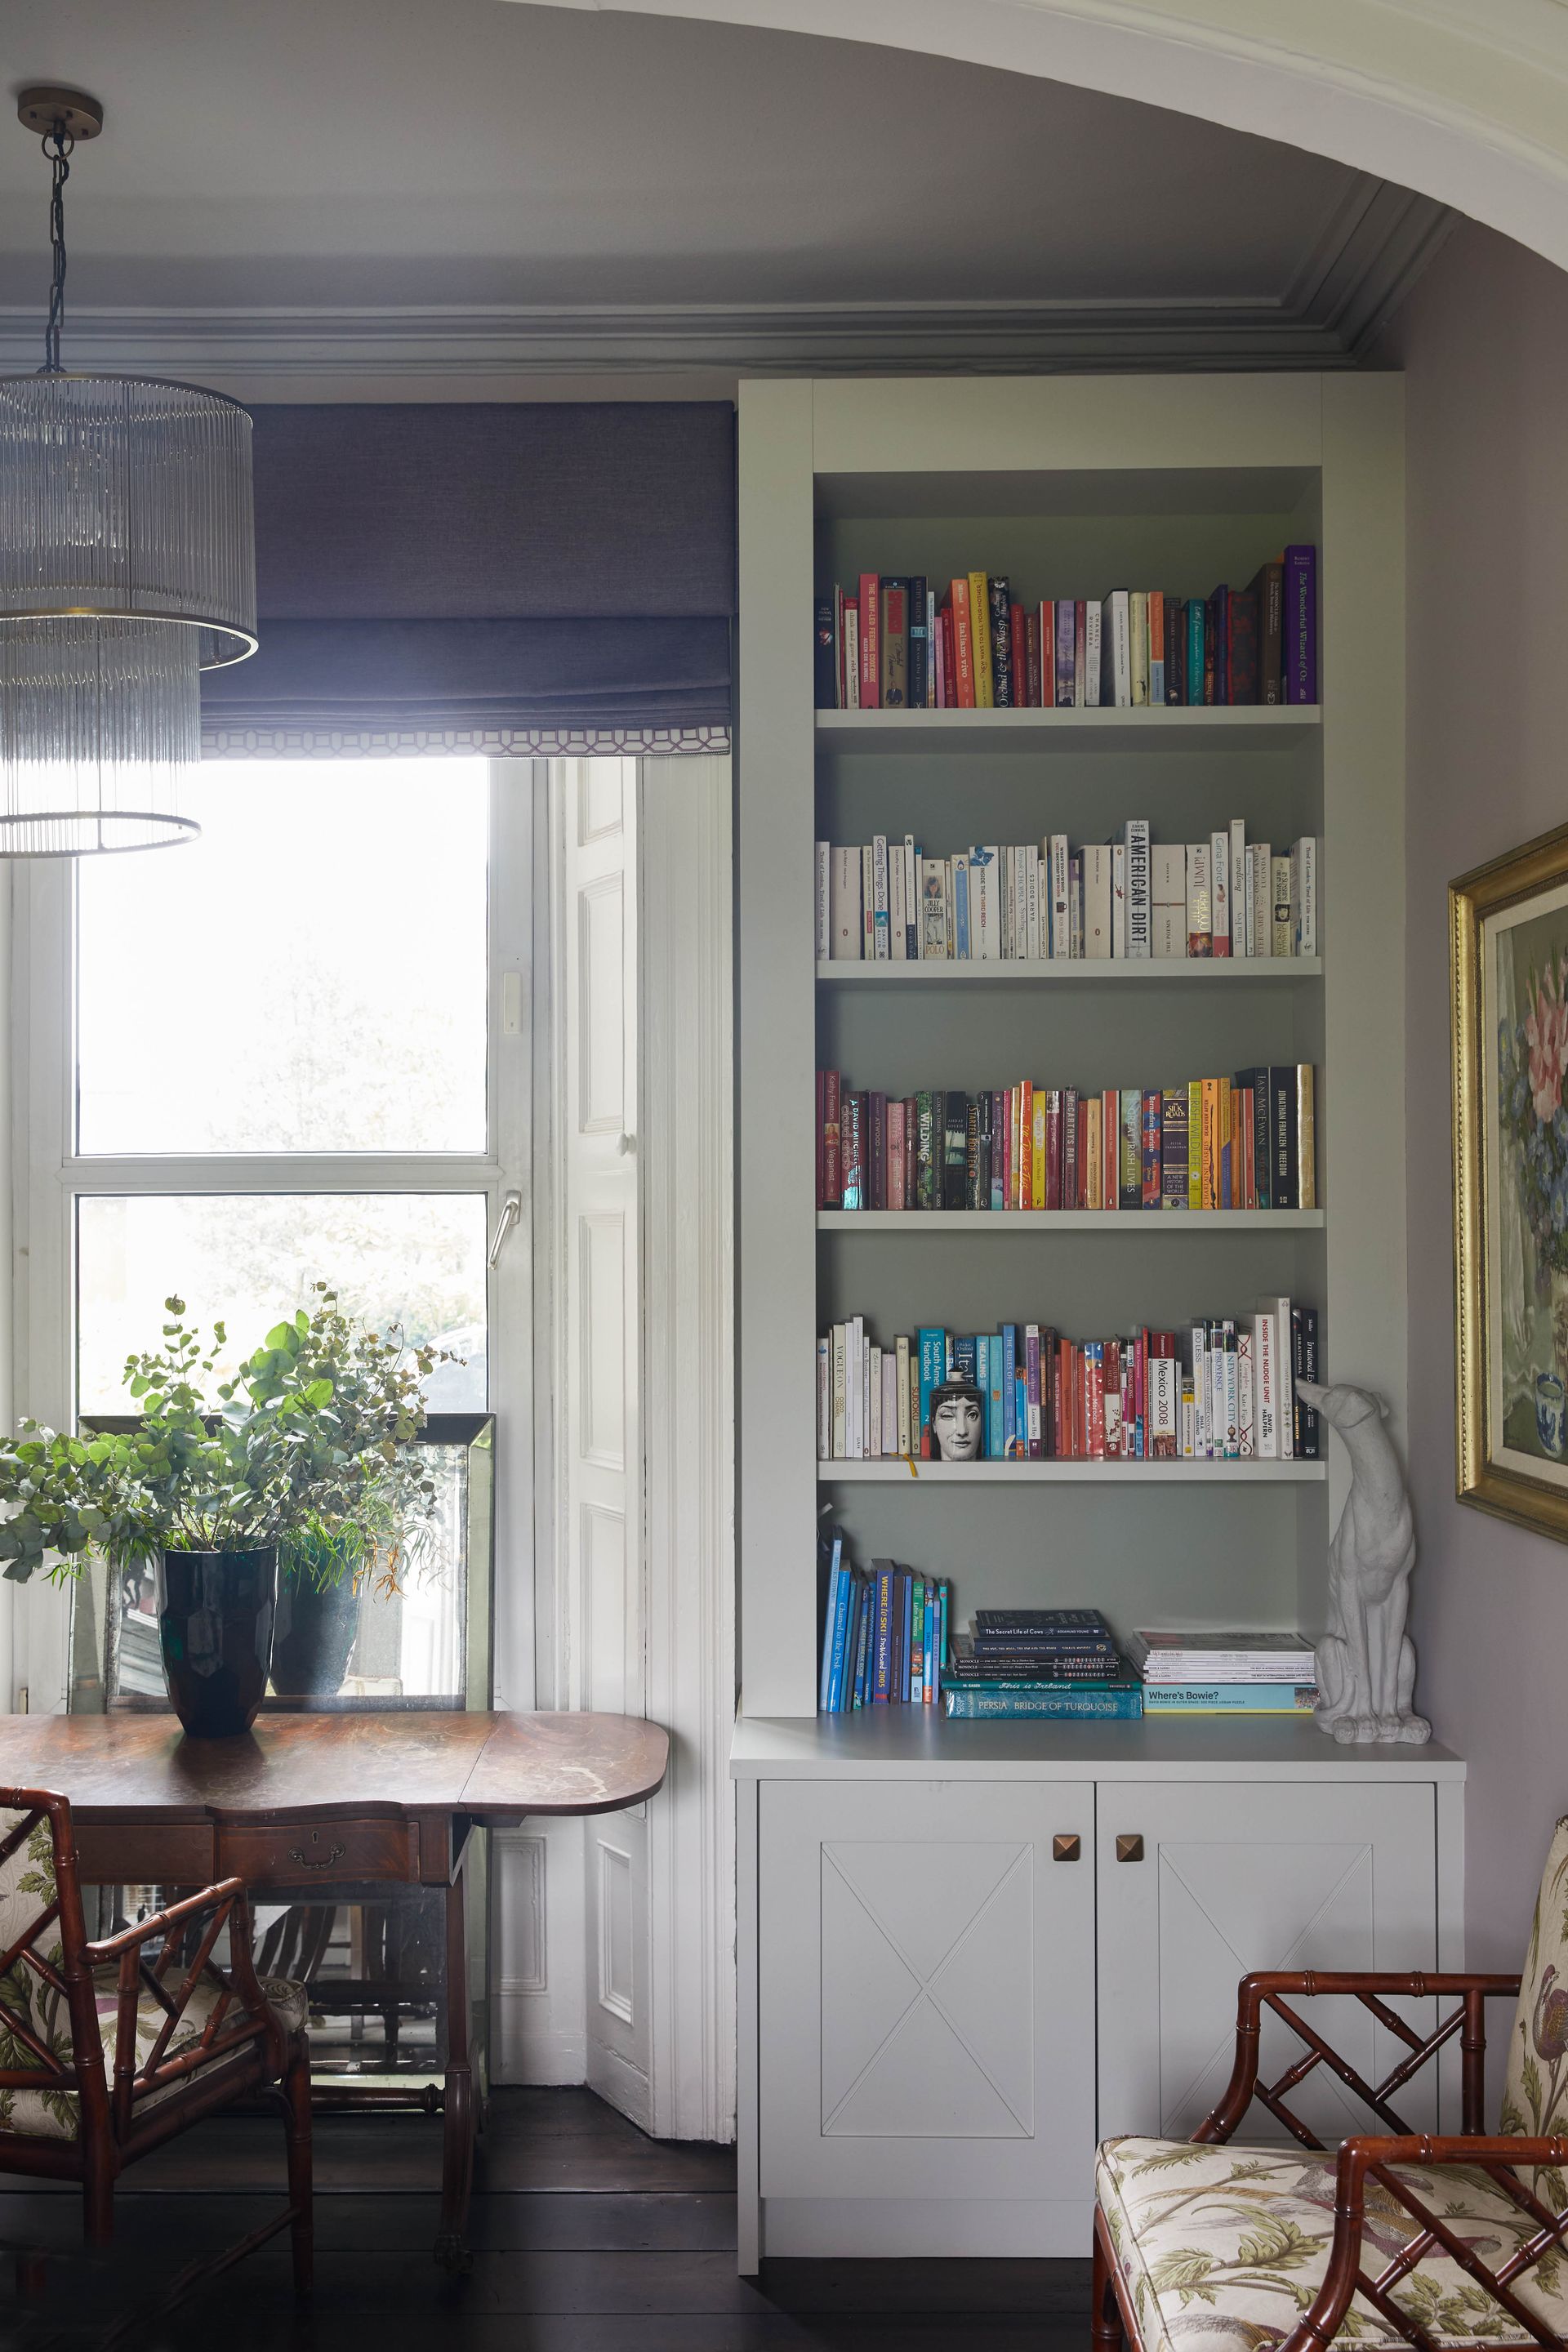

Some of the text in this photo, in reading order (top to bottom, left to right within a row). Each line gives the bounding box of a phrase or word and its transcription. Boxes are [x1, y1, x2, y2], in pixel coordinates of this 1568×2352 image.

[1299, 572, 1307, 586] The
[888, 590, 902, 635] SPANISH
[996, 620, 1007, 645] Wasp
[996, 645, 1006, 661] the
[1298, 661, 1307, 669] of
[1300, 670, 1307, 682] Oz
[998, 675, 1008, 707] Orchid
[875, 838, 884, 866] Getting
[875, 866, 884, 890] Things
[1216, 861, 1224, 882] Ford
[1234, 857, 1245, 892] Bossypants
[1131, 835, 1147, 942] AMERICAN DIRT
[925, 945, 944, 954] POLO
[920, 1112, 930, 1161] WILDING
[968, 1107, 978, 1168] STARTER FOR TEN
[1067, 1095, 1075, 1164] McCARTHY'S BAR
[1190, 1098, 1200, 1167] IRISH WILDLIFE
[1278, 1089, 1288, 1176] JONATHAN FRANZEN FREEDOM
[1127, 1107, 1136, 1193] GREAT IRISH LIVES
[828, 1148, 836, 1181] Veganist
[1195, 1331, 1202, 1343] DO
[923, 1341, 931, 1381] Handbook
[1306, 1341, 1315, 1372] Irrational
[836, 1376, 843, 1388] ON
[1006, 1371, 1013, 1379] OF
[1227, 1374, 1236, 1402] YORK
[911, 1386, 920, 1421] SUDOKU
[1158, 1361, 1169, 1425] Mexico 2008
[1227, 1403, 1236, 1423] CITY
[1241, 1410, 1249, 1425] Figes
[880, 1576, 889, 1608] WHERE
[836, 1602, 846, 1630] Chained
[880, 1608, 889, 1616] to
[835, 1640, 843, 1650] the
[833, 1651, 842, 1669] Desk
[878, 1669, 886, 1687] 2005
[978, 1701, 1008, 1710] PERSIA
[1014, 1702, 1047, 1710] BRIDGE
[1049, 1702, 1062, 1710] OF
[1063, 1703, 1118, 1712] TURQUOISE
[1148, 1691, 1219, 1699] Where's Bowie?
